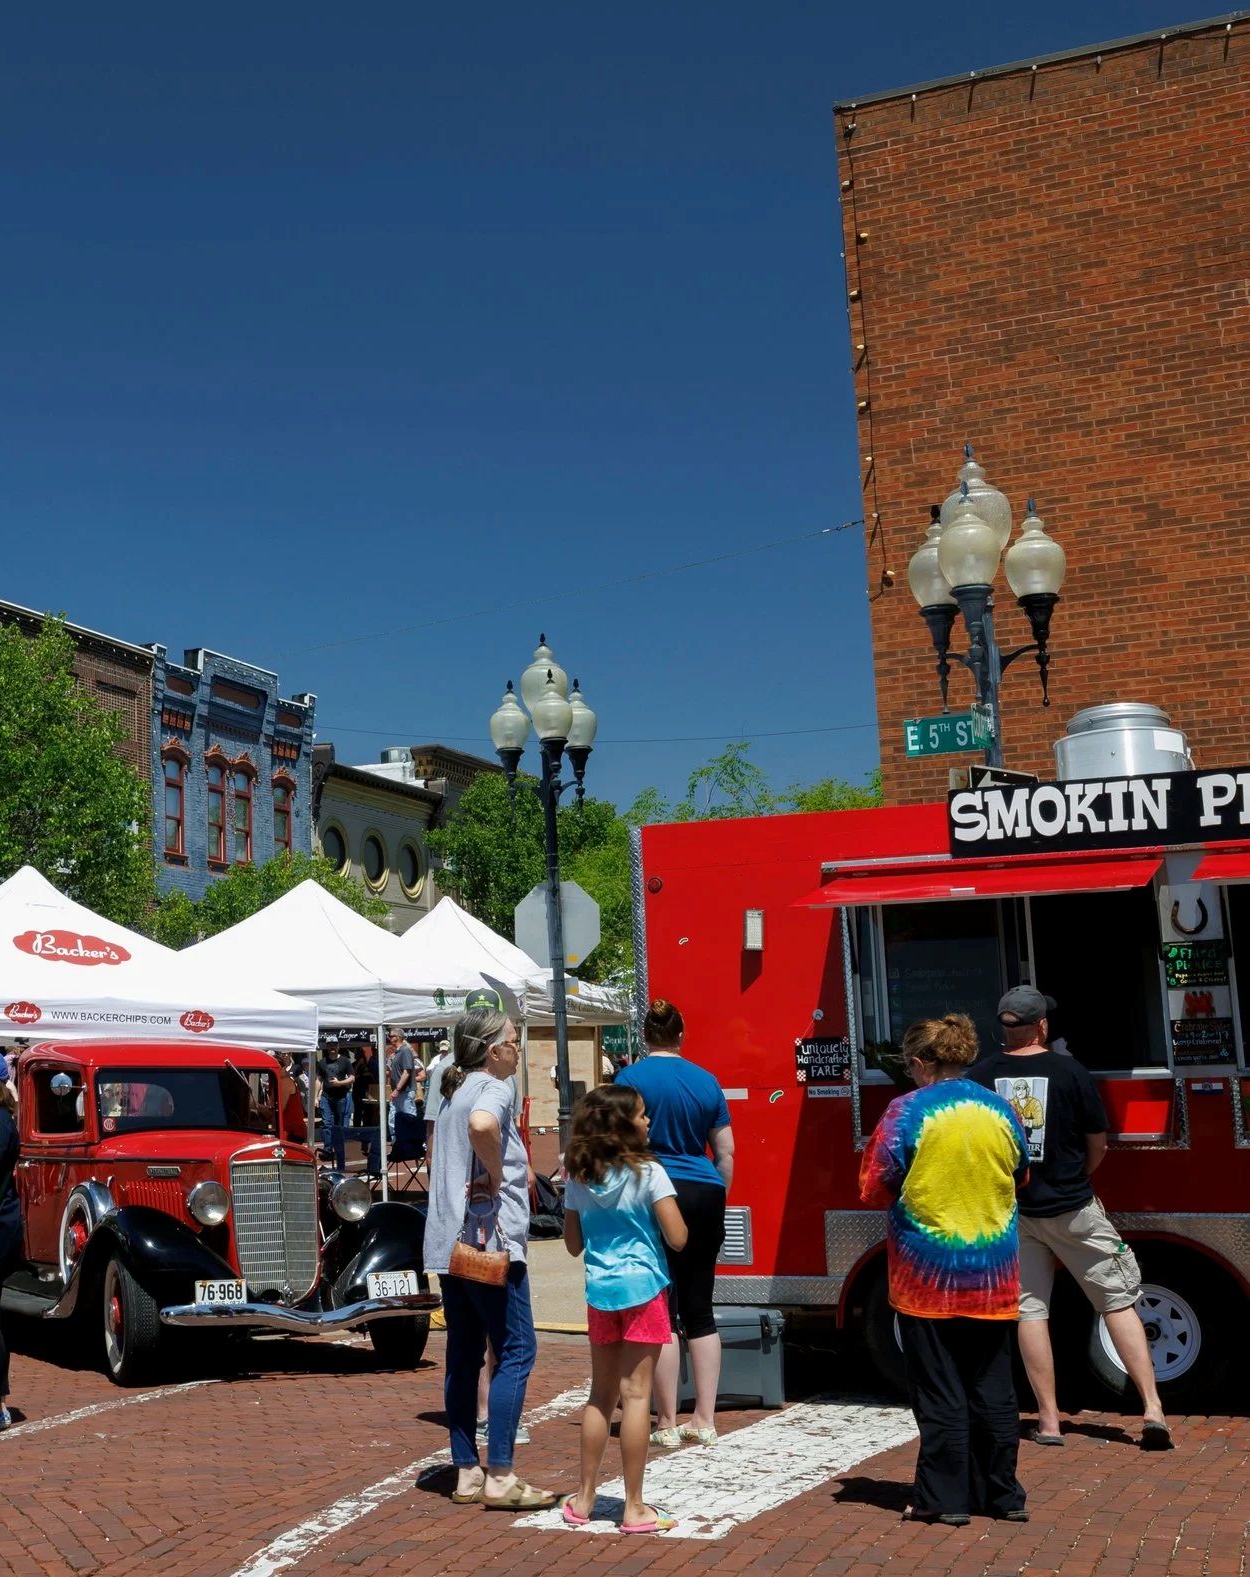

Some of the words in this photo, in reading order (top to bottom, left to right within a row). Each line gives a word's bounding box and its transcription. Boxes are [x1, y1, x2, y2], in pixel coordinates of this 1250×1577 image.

[906, 725, 924, 751] E.
[929, 723, 950, 749] 5TH
[950, 778, 1171, 842] SMOKIN
[32, 933, 120, 960] Backer's
[9, 1003, 39, 1020] Backer's
[51, 1010, 172, 1026] WWW.BACKERCHIPS.COM
[184, 1013, 211, 1028] Backer's
[338, 1028, 359, 1042] Lager
[810, 1064, 841, 1077] FARE
[817, 1088, 840, 1096] Smoking
